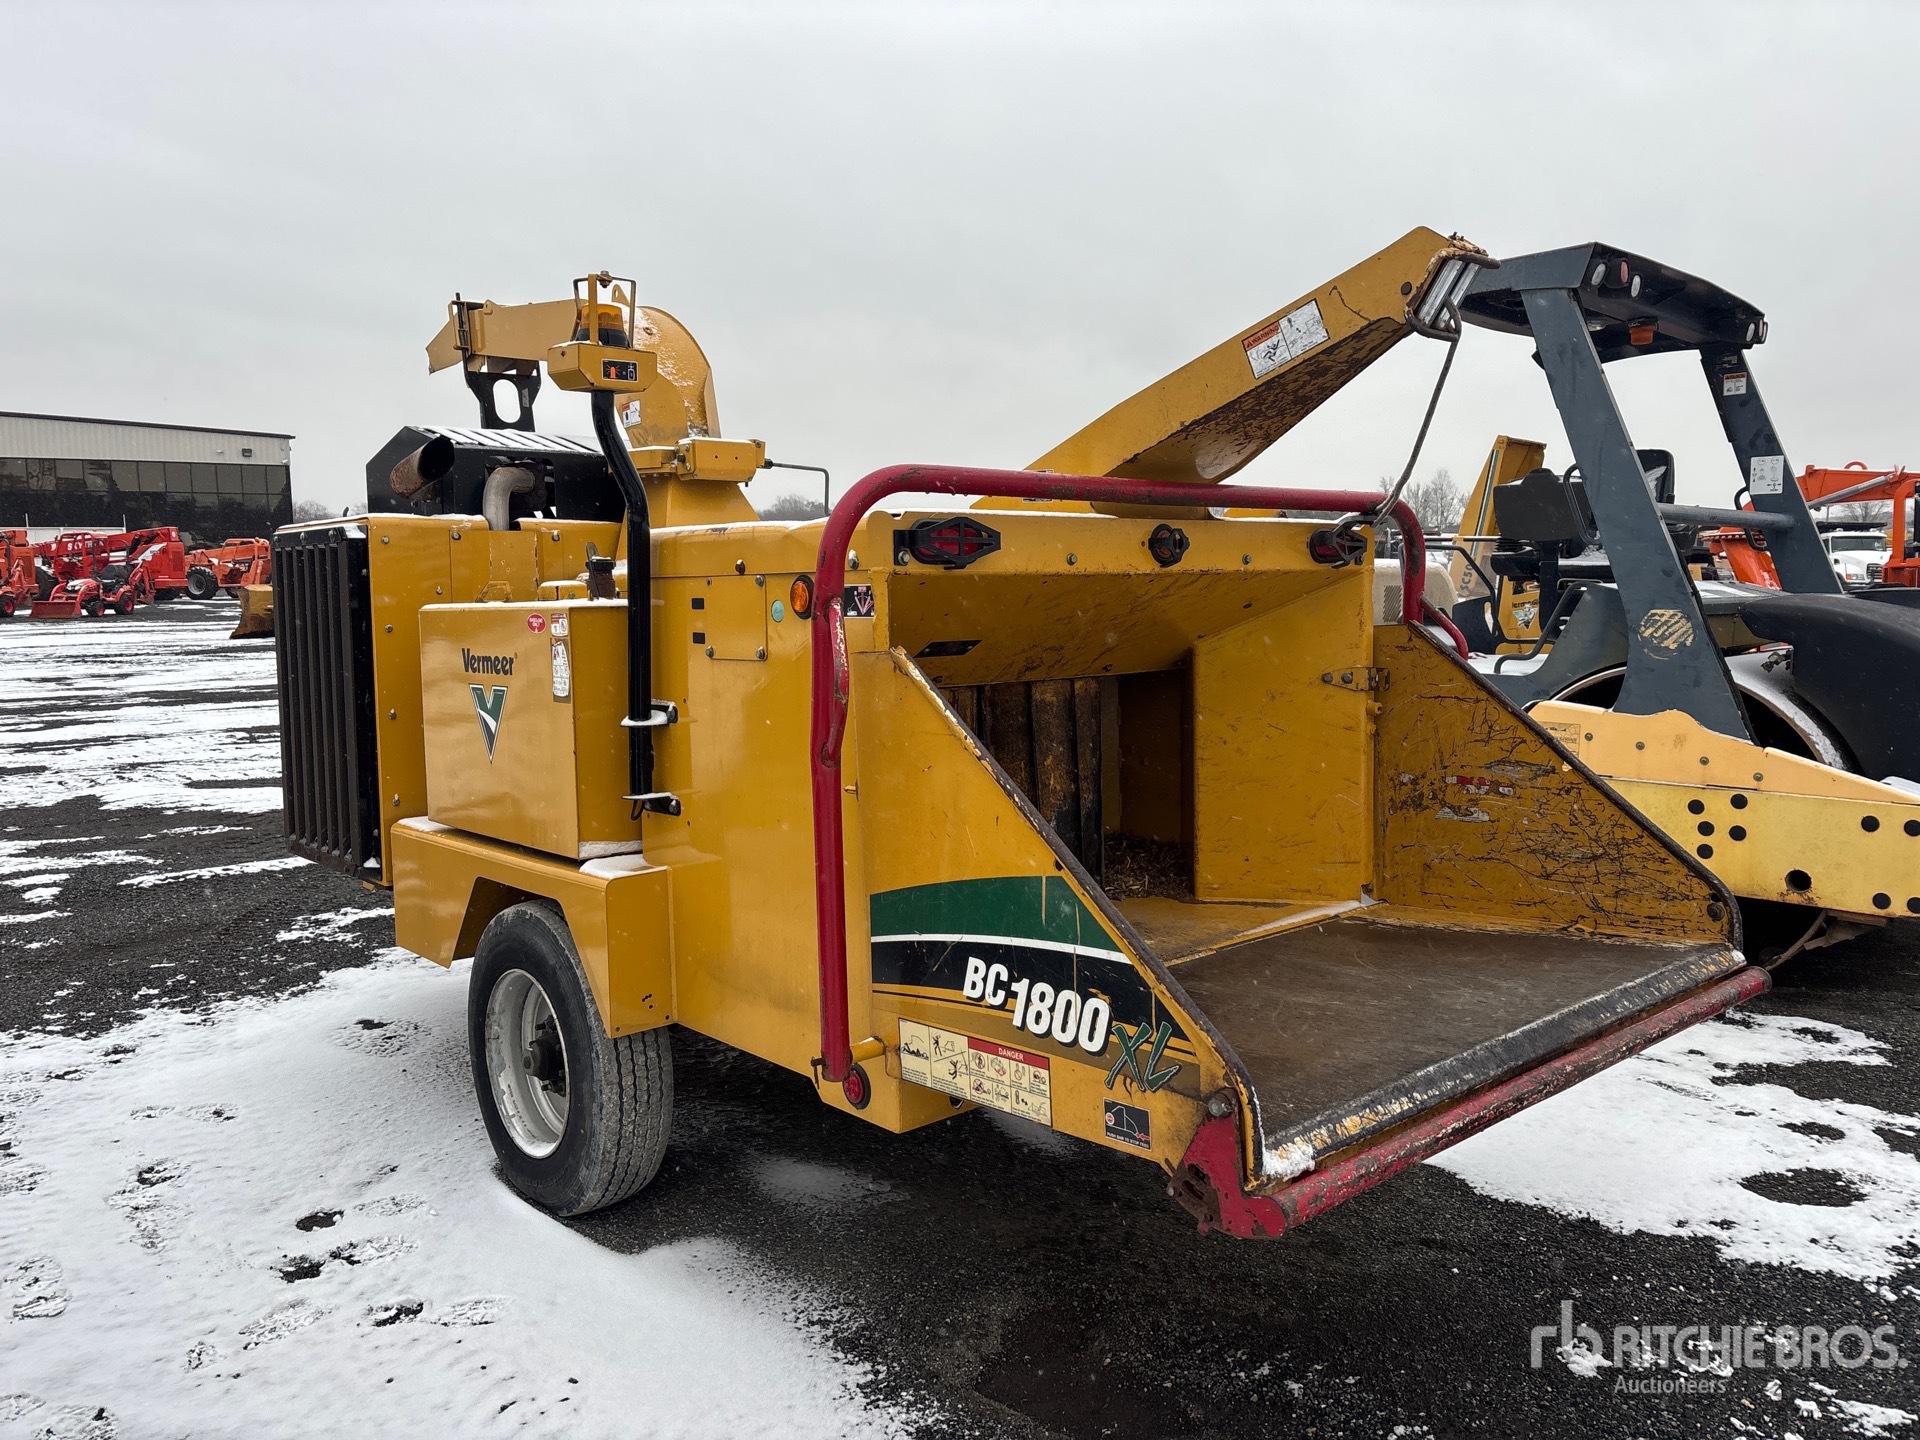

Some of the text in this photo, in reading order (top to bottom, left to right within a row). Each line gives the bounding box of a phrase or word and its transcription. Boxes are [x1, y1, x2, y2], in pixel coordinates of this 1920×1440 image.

[461, 647, 515, 676] Vermeer
[998, 1047, 1024, 1061] DANGER
[1104, 1021, 1182, 1092] XL
